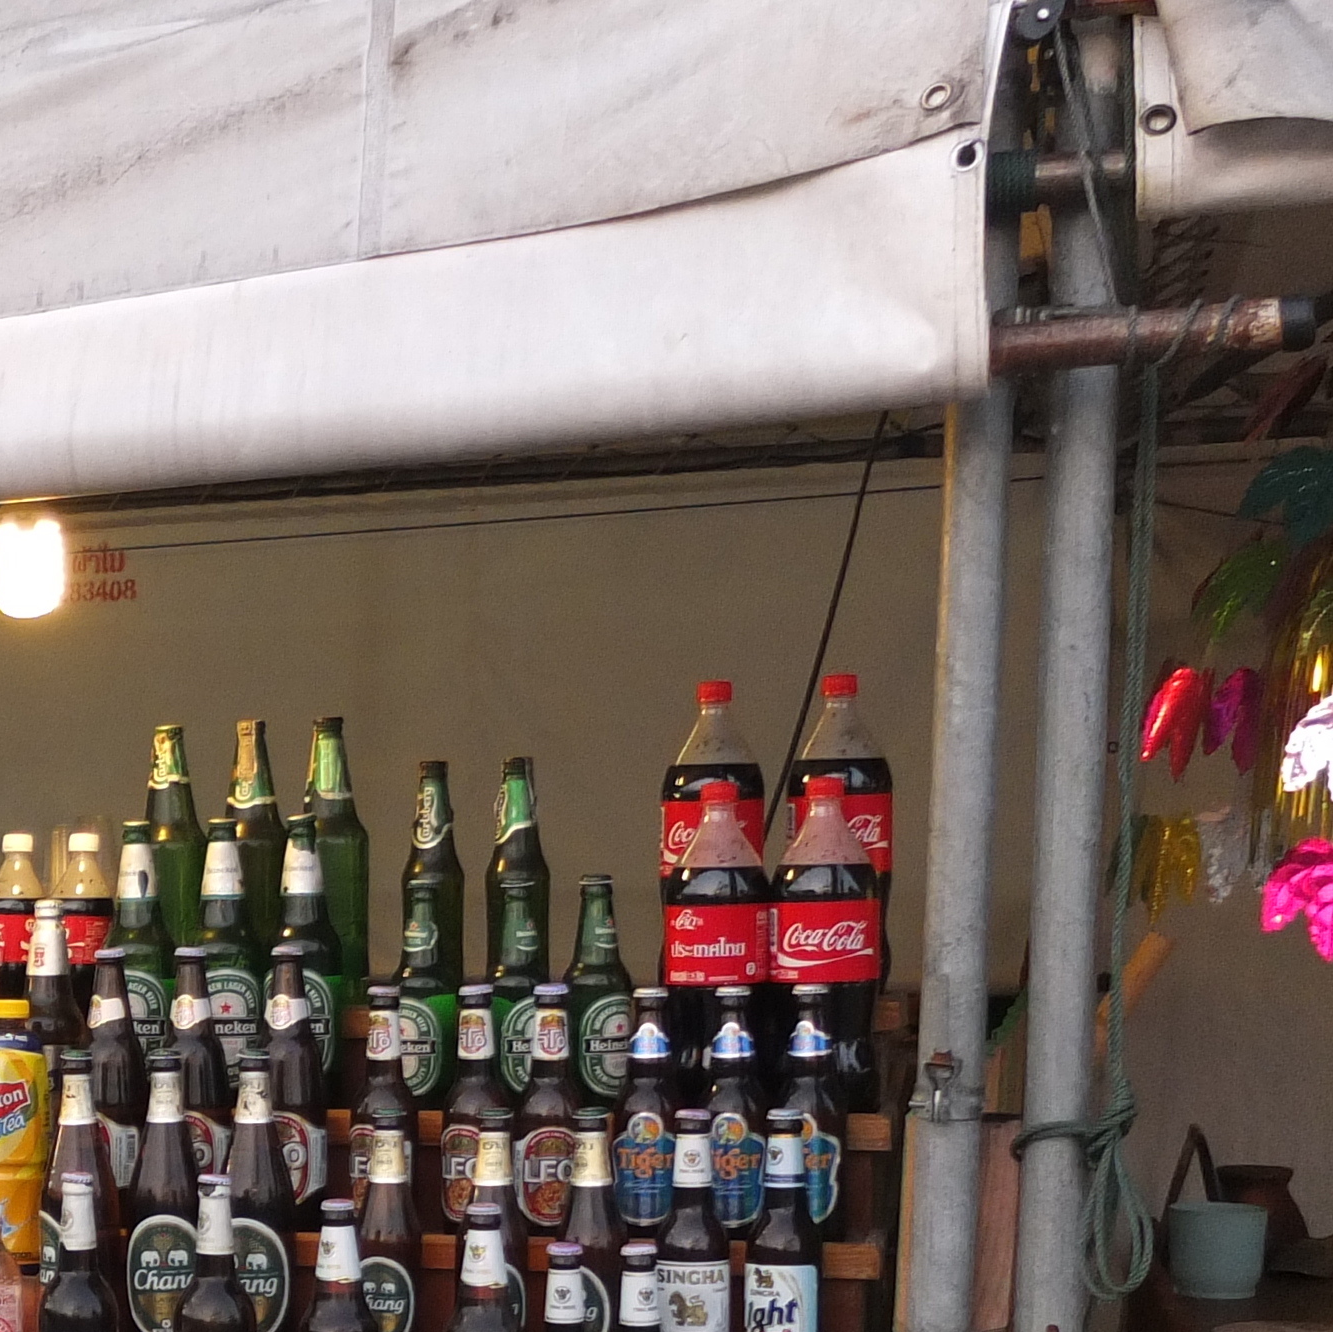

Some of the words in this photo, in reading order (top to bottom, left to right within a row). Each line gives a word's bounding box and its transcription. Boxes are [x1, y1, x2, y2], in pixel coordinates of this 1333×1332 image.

[783, 920, 868, 952] Coca-Cola
[0, 1113, 26, 1135] Tea
[523, 1158, 573, 1182] LEO
[617, 1147, 673, 1178] Tiger
[240, 1277, 278, 1297] ang
[658, 1268, 726, 1285] SINGHA
